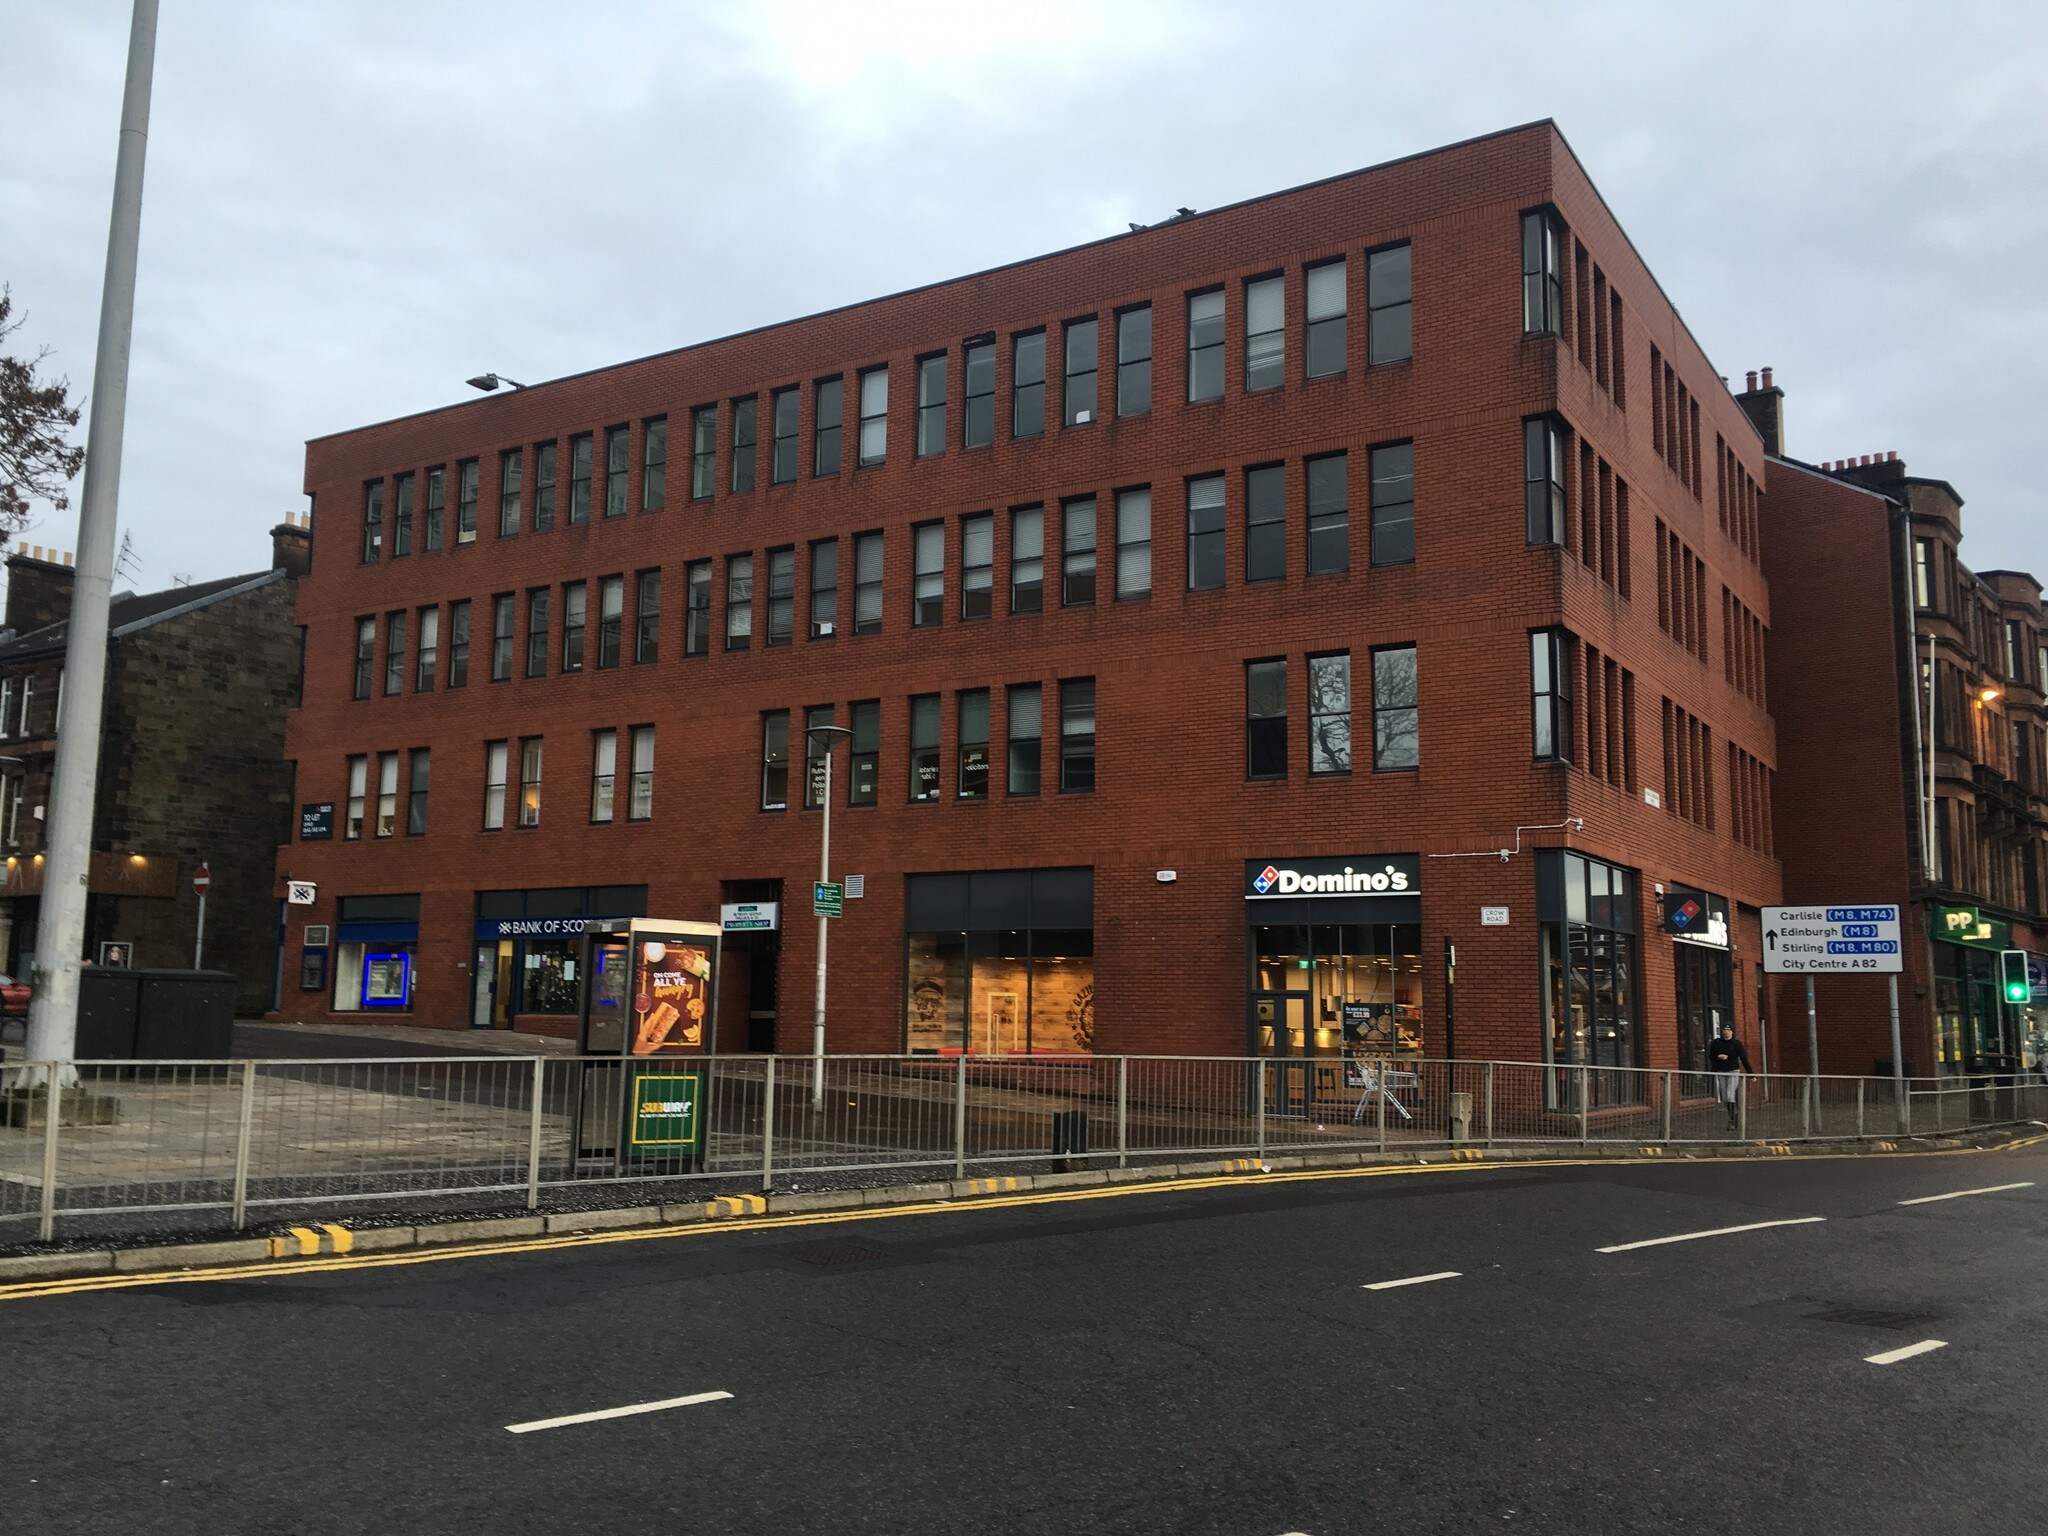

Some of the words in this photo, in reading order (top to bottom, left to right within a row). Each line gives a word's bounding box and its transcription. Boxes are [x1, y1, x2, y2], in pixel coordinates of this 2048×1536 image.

[1279, 865, 1408, 893] Domino's
[1780, 911, 1823, 920] Carlisle
[512, 920, 542, 934] BANK
[544, 920, 560, 933] OF
[562, 919, 586, 933] SCO
[1946, 912, 1973, 931] PP
[1780, 927, 1838, 938] Edinburgh
[1782, 943, 1824, 953] Stirling
[1783, 959, 1805, 969] City
[1809, 960, 1847, 969] Centre
[653, 978, 672, 987] ALL
[673, 978, 687, 986] YE
[640, 1101, 692, 1113] SUBWAY
